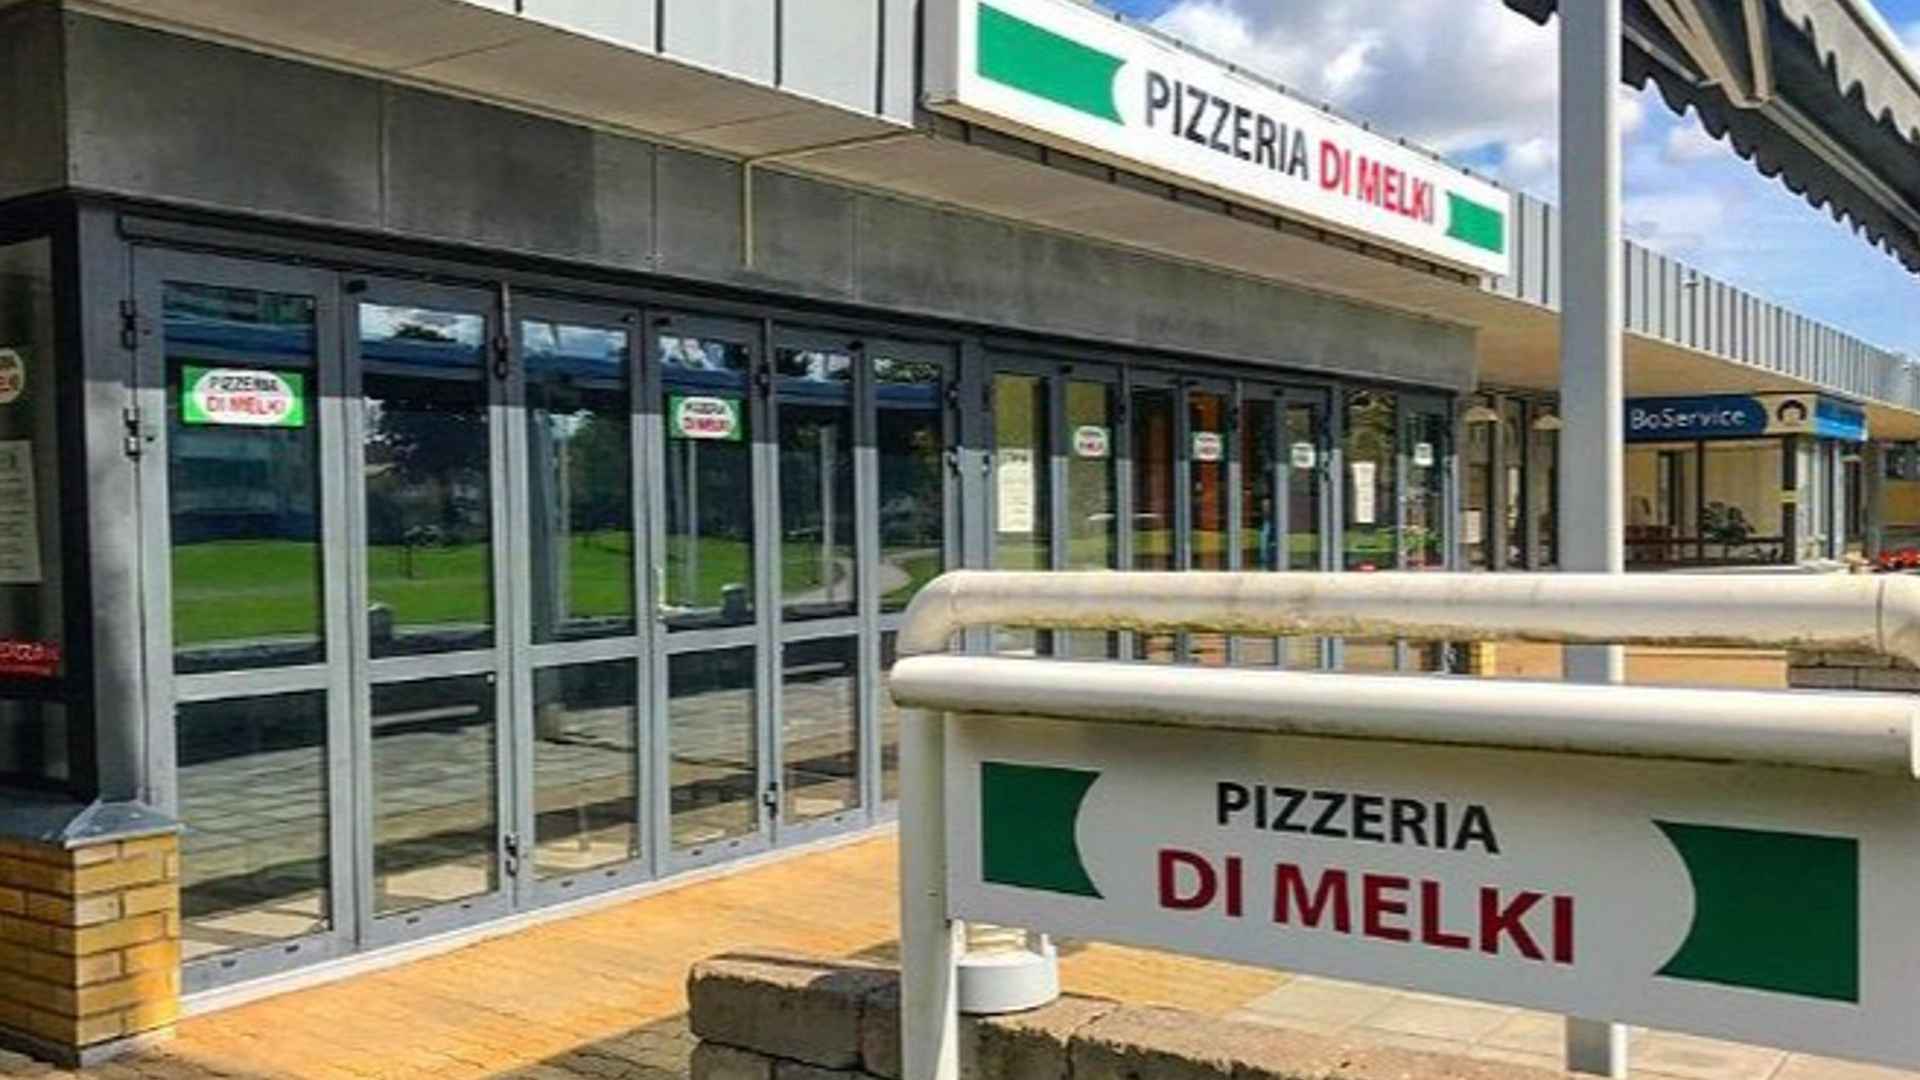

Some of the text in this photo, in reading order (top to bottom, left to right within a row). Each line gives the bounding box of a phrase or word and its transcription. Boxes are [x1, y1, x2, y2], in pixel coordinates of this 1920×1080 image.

[1145, 71, 1435, 225] PIZZERIA DI MELKI
[207, 395, 286, 415] DI MELKI
[1630, 407, 1746, 431] BoService
[1215, 781, 1501, 856] PIZZERIA
[1157, 848, 1575, 966] DI MELKI
